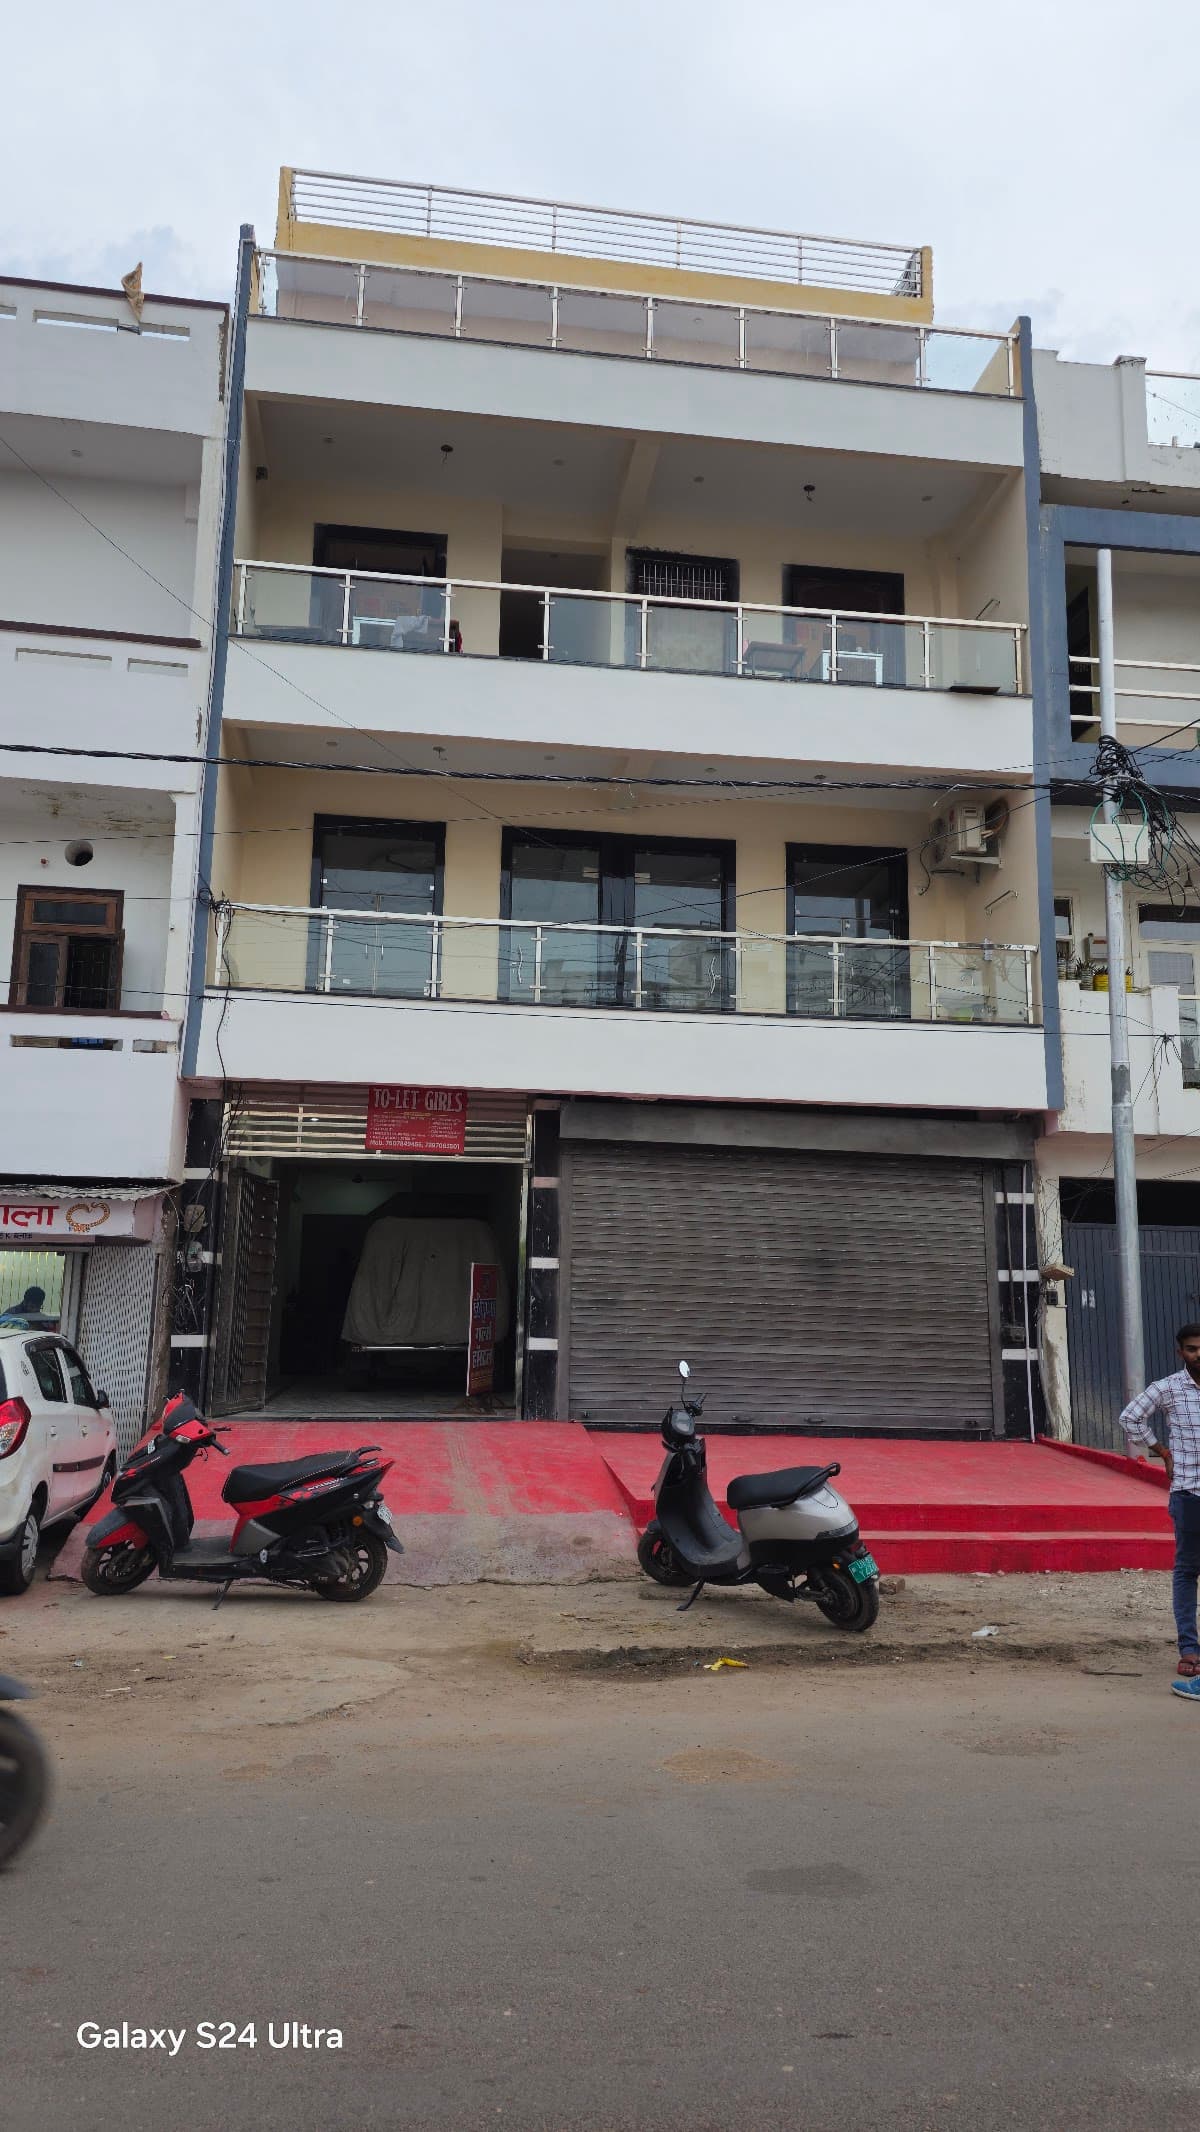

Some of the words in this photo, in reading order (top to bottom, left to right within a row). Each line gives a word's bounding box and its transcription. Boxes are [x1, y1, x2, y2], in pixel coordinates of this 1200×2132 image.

[374, 1088, 420, 1110] TO-LET
[424, 1090, 463, 1113] GIRLS
[0, 1205, 59, 1227] ाला
